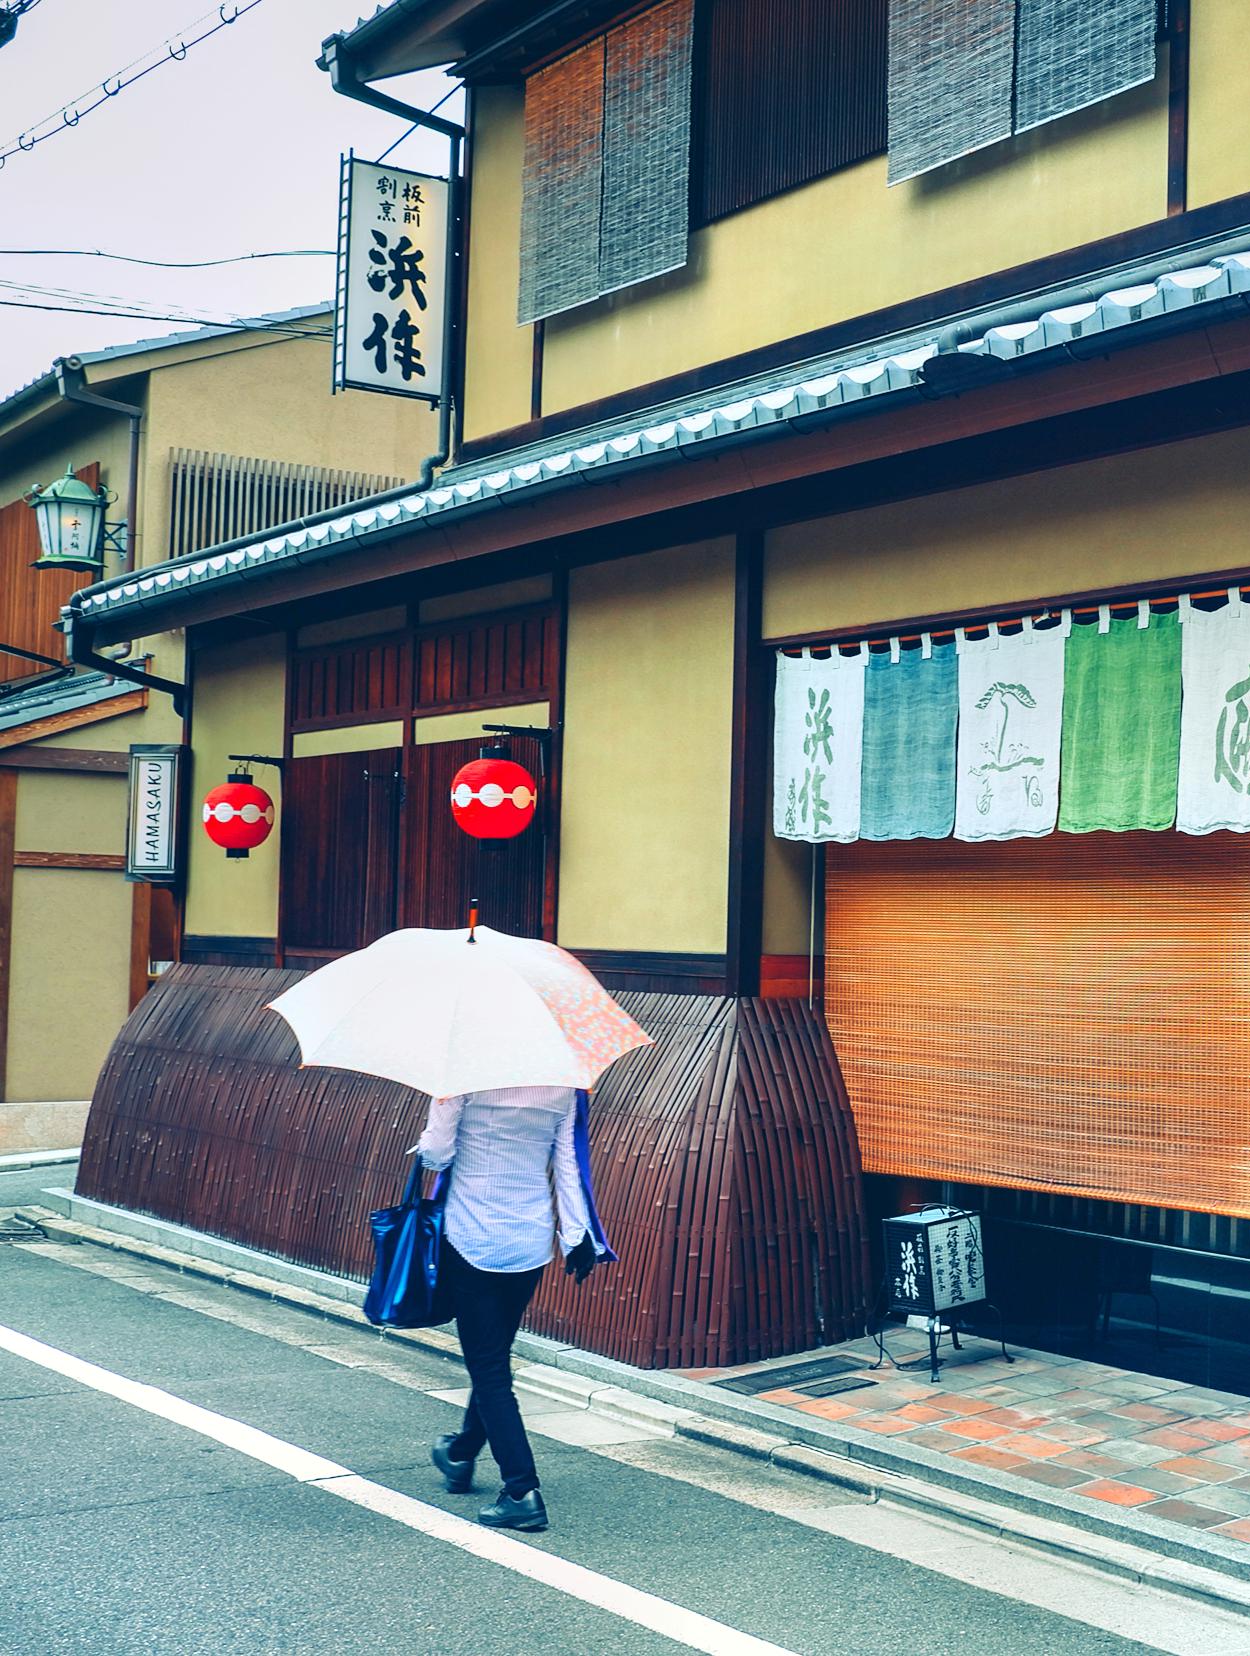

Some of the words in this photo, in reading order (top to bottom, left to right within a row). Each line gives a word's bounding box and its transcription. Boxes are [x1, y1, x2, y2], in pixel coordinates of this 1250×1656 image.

[376, 176, 397, 222] 割烹
[402, 182, 425, 227] 板前
[362, 229, 428, 381] 浜作
[798, 687, 835, 834] 浜作
[145, 762, 162, 862] HAMASAKU
[900, 1241, 920, 1300] 浜作
